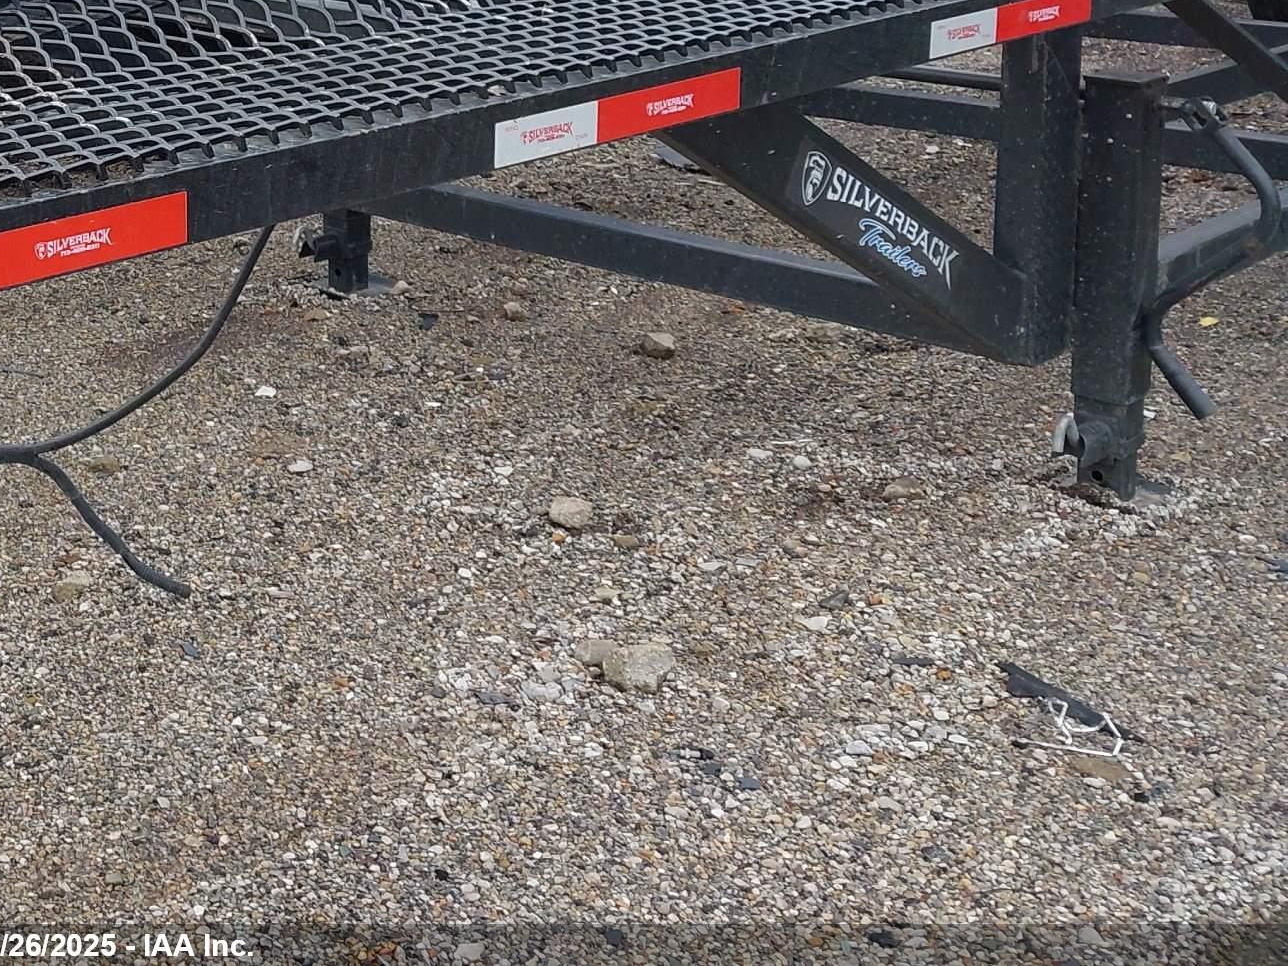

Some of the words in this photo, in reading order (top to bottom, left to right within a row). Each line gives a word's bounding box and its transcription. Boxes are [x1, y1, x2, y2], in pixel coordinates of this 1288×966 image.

[528, 121, 574, 143] SILVERBACK
[47, 227, 113, 259] SILVERBACK
[826, 166, 960, 291] SILVERBACK
[858, 217, 927, 277] Trailers
